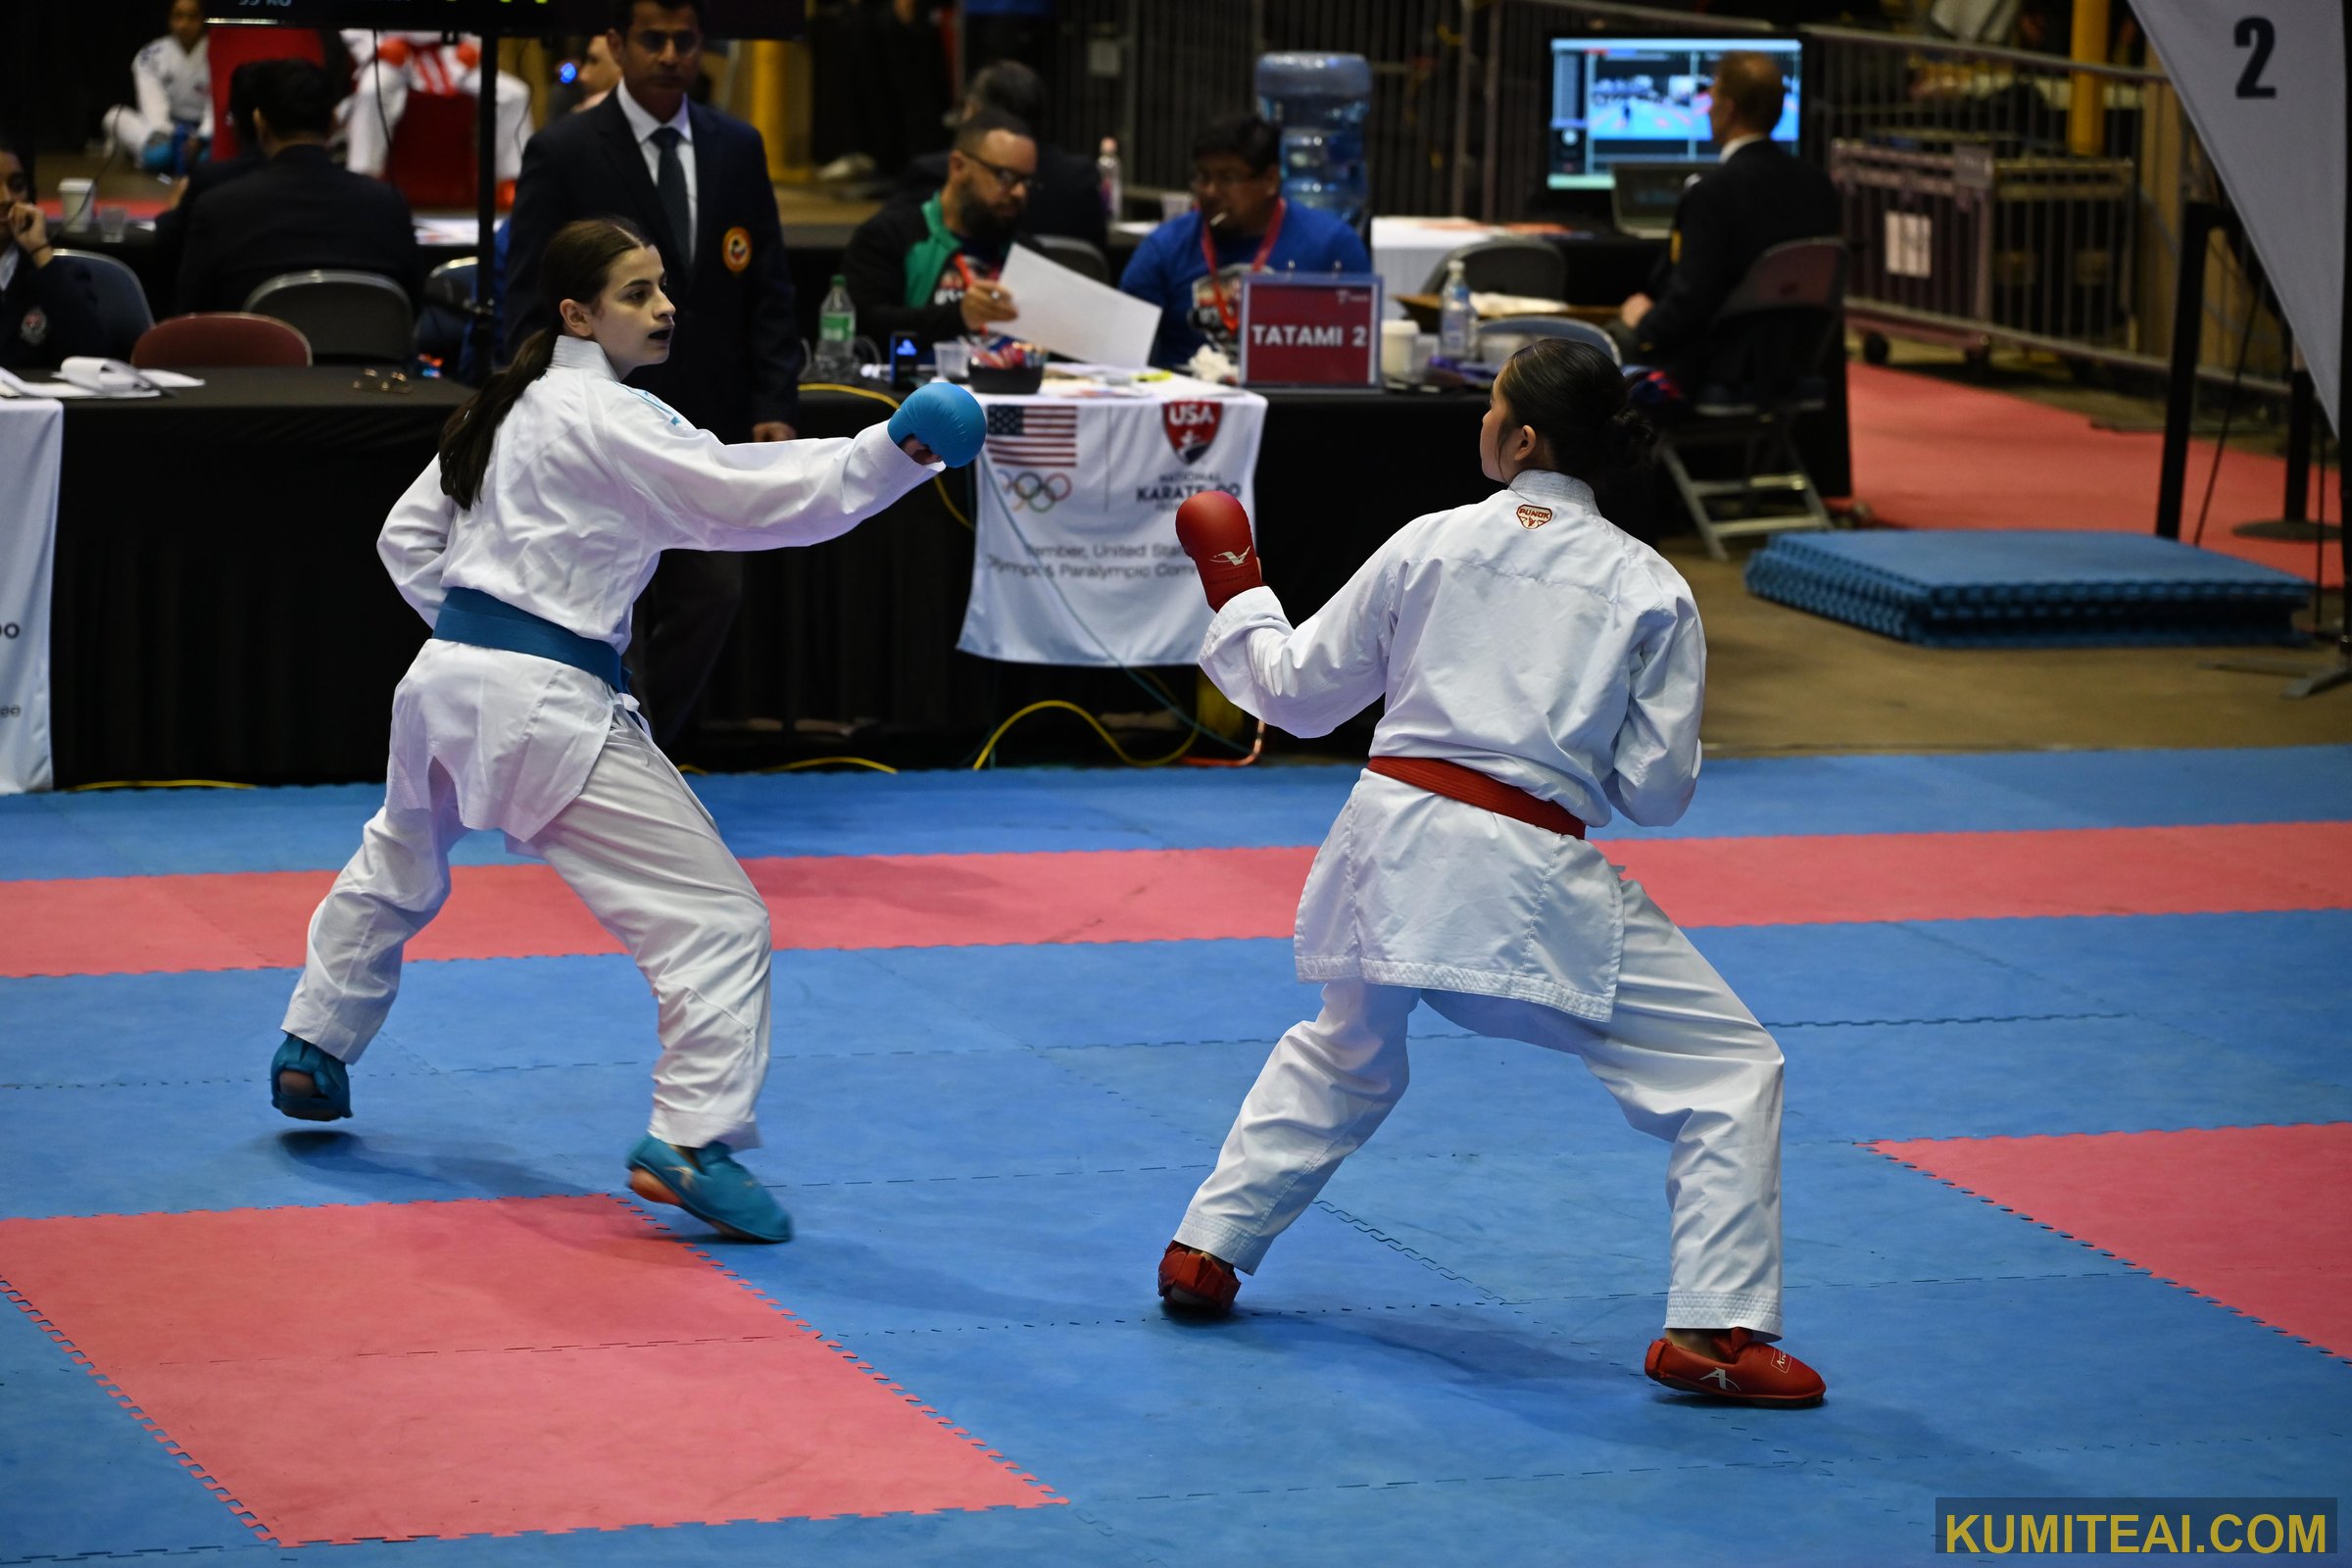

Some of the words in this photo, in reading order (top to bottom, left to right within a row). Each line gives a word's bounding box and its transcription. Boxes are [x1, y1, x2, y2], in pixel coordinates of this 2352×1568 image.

[2233, 16, 2277, 99] 2
[1250, 324, 1344, 346] TATAMI
[1351, 324, 1367, 347] 2
[1169, 403, 1214, 425] USA
[1518, 508, 1549, 519] PUNOK
[1093, 543, 1147, 558] United
[1059, 562, 1151, 580] Paralympic
